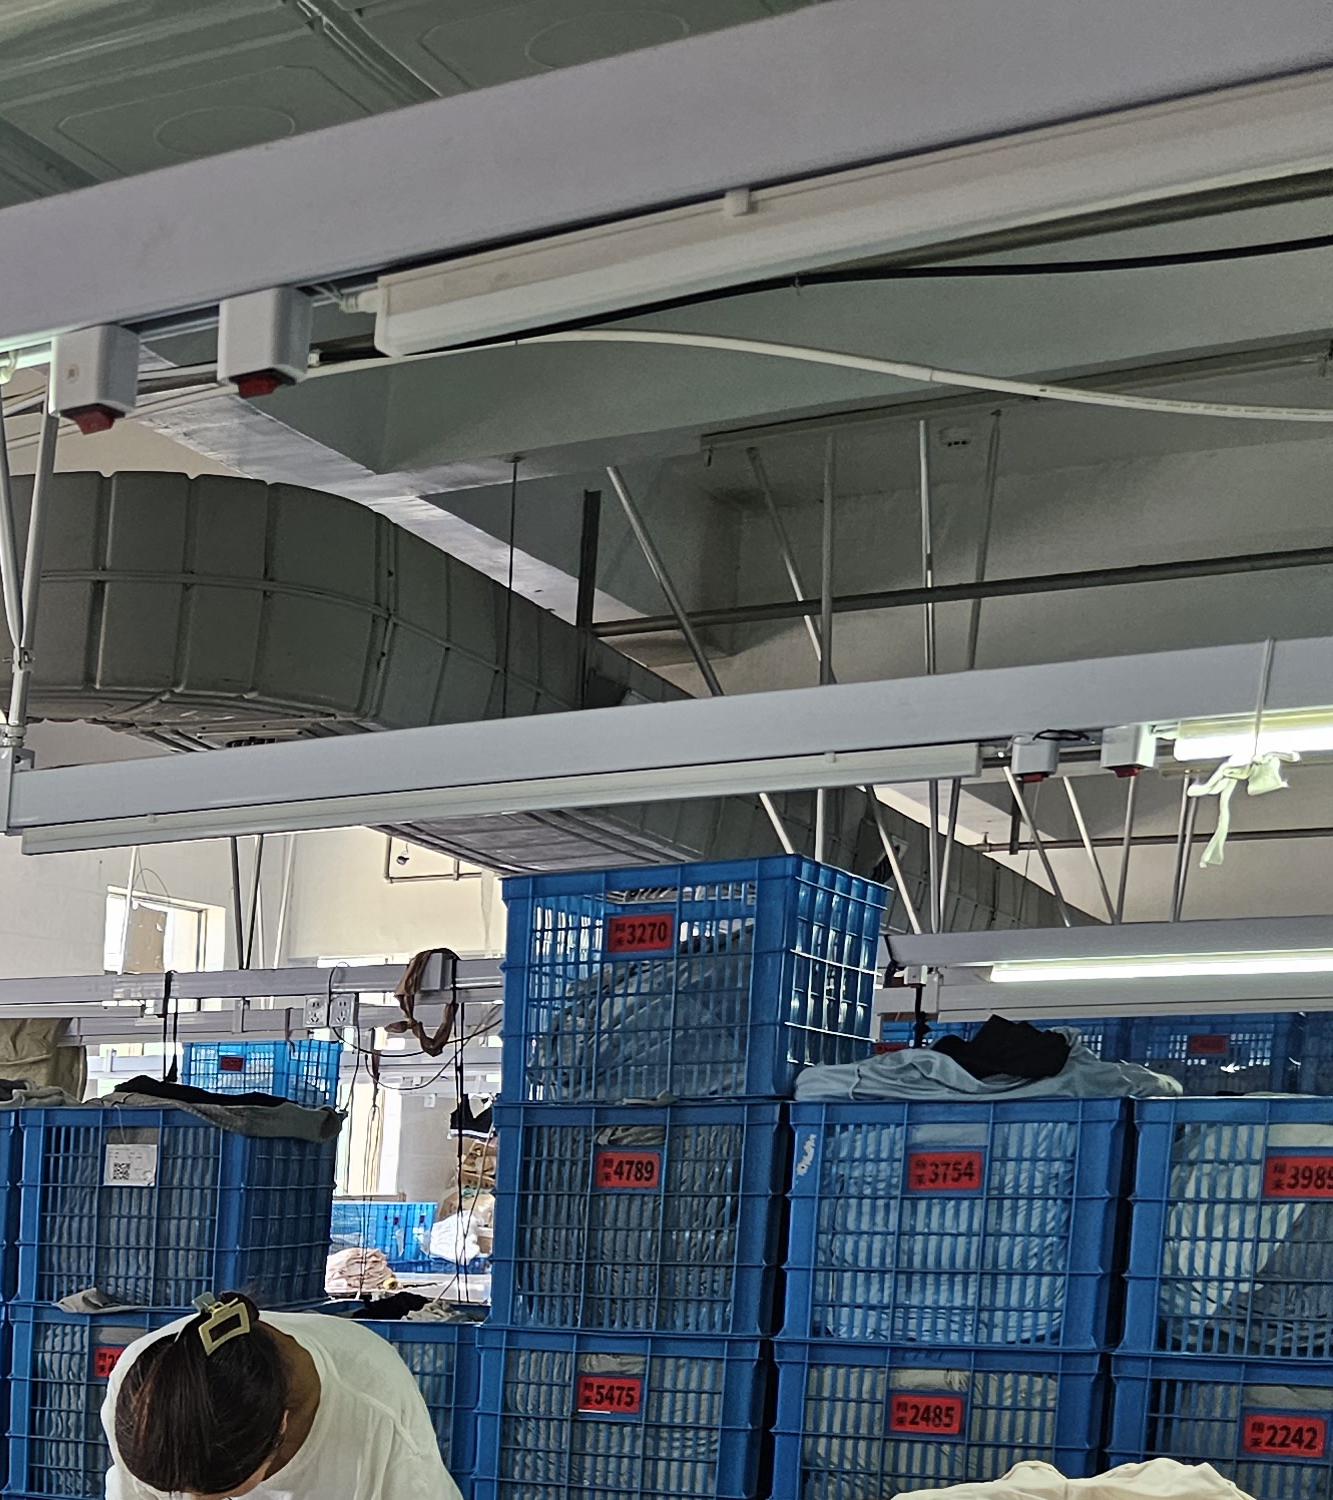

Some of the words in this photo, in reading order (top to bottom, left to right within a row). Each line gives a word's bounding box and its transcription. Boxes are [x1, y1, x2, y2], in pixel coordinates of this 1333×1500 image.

[627, 921, 667, 944] 3270
[613, 1160, 654, 1182] 4789
[929, 1159, 975, 1183] 3754
[594, 1384, 636, 1407] 5475
[908, 1403, 955, 1428] 2485
[1265, 1424, 1318, 1450] 2242
